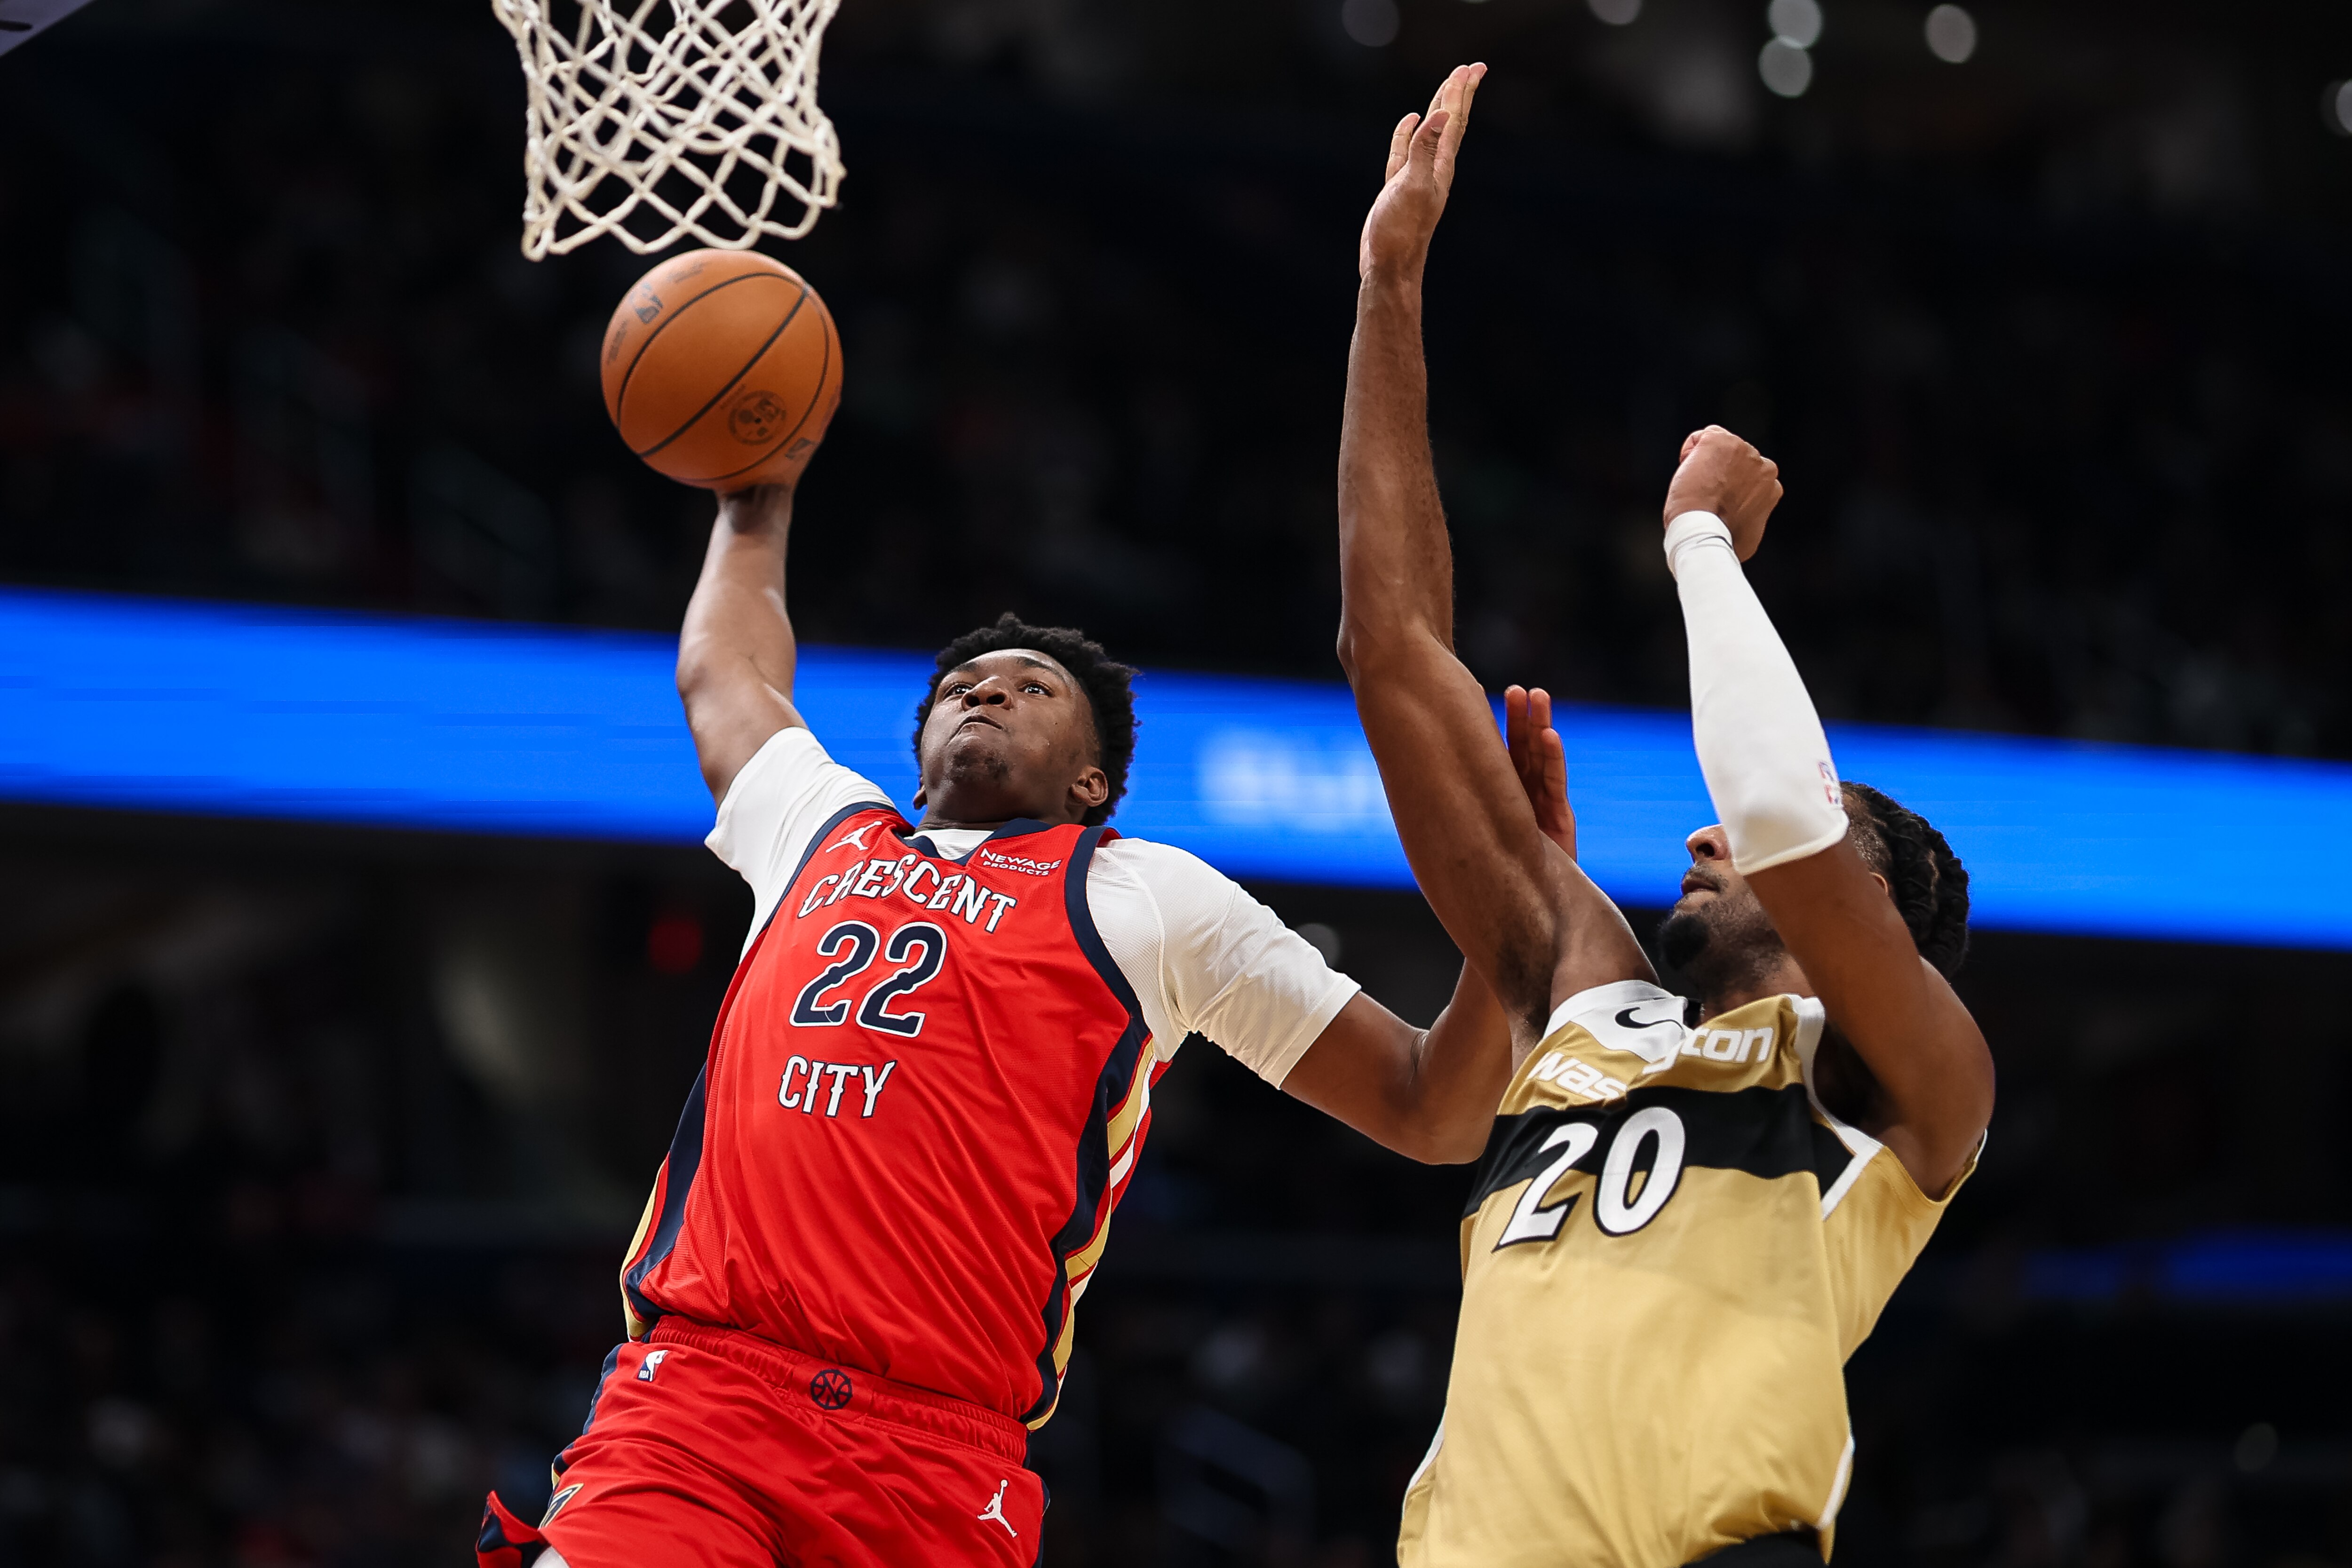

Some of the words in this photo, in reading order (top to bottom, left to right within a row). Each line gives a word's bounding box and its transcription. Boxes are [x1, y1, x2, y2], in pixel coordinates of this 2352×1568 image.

[980, 848, 1062, 870] NEWAGE
[983, 861, 1049, 876] PRODUCTS
[797, 853, 1017, 934] CRESCENT
[789, 920, 947, 1038] 22
[778, 1054, 896, 1118] CITY
[1492, 1106, 1686, 1253] 20
[638, 1369, 650, 1379] NBA
